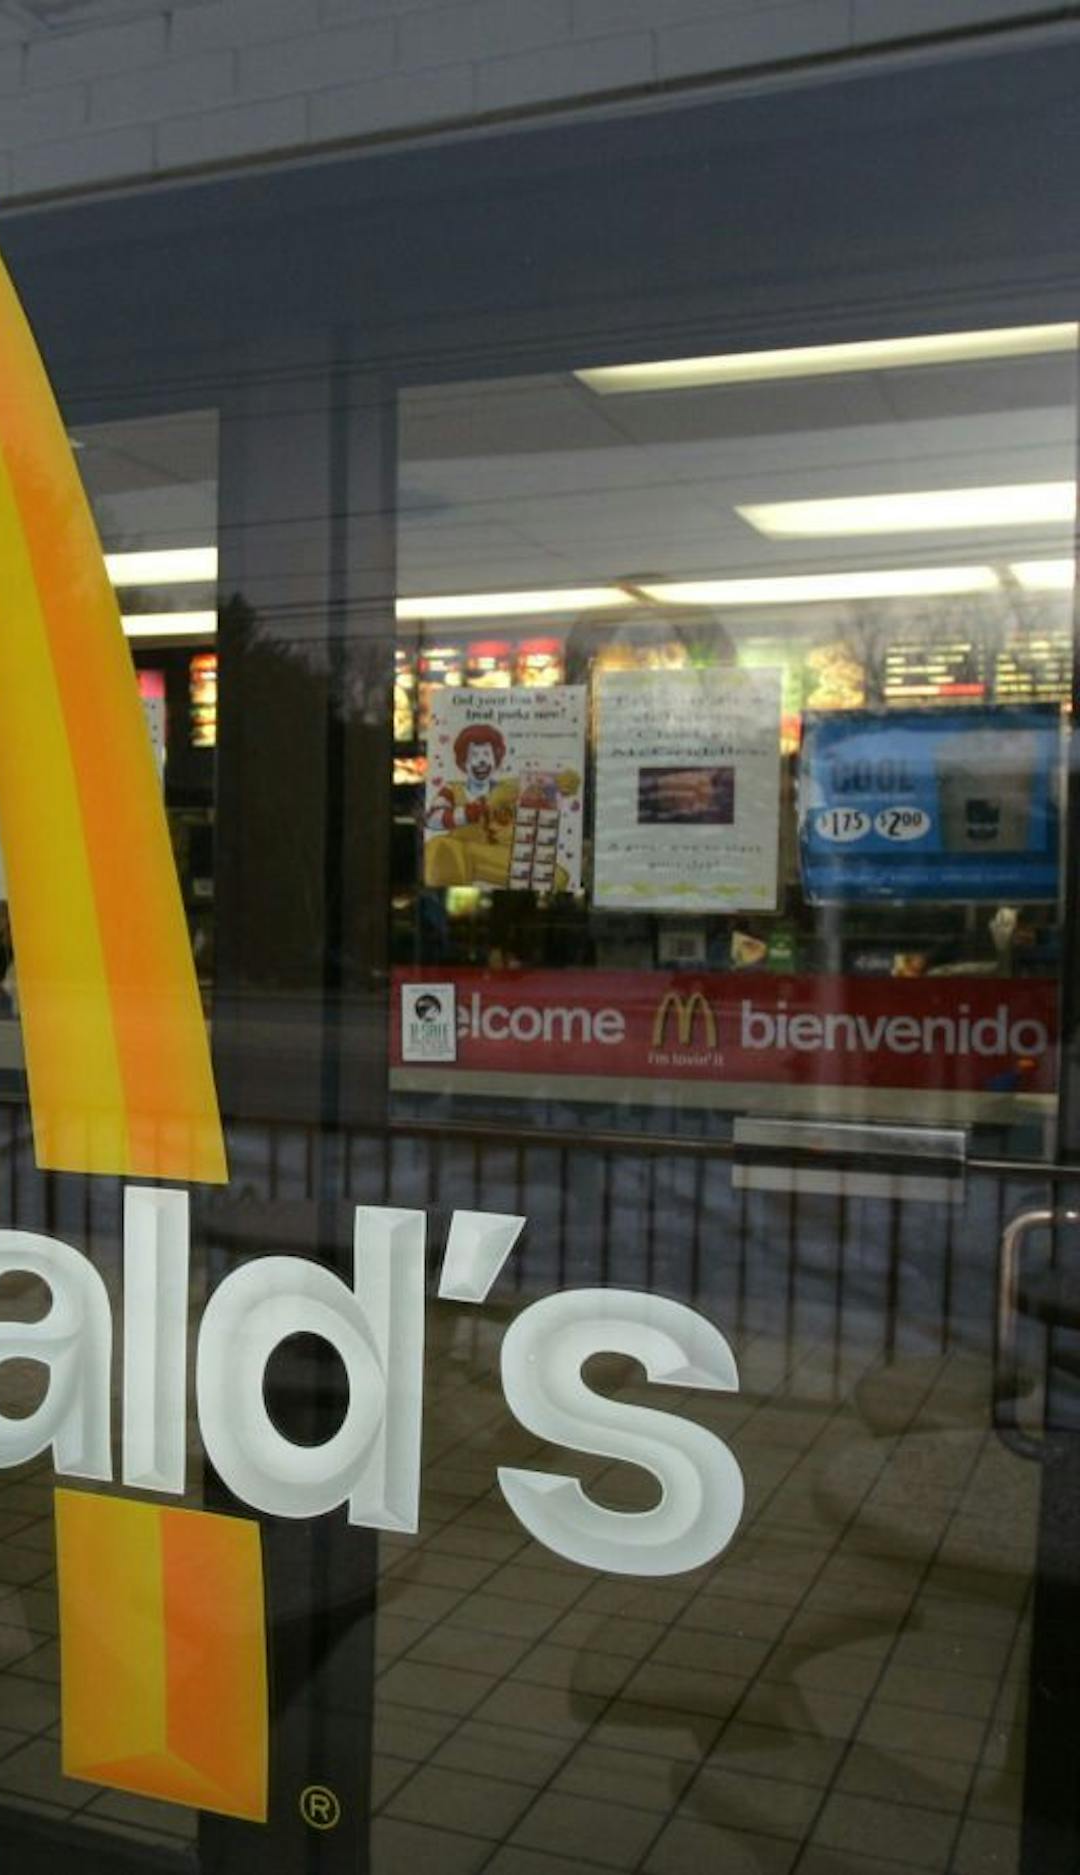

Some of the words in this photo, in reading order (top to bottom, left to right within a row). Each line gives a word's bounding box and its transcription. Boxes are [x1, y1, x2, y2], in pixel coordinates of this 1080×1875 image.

[456, 992, 626, 1044] elcome
[741, 999, 1048, 1056] bienvenido
[714, 1051, 725, 1066] it
